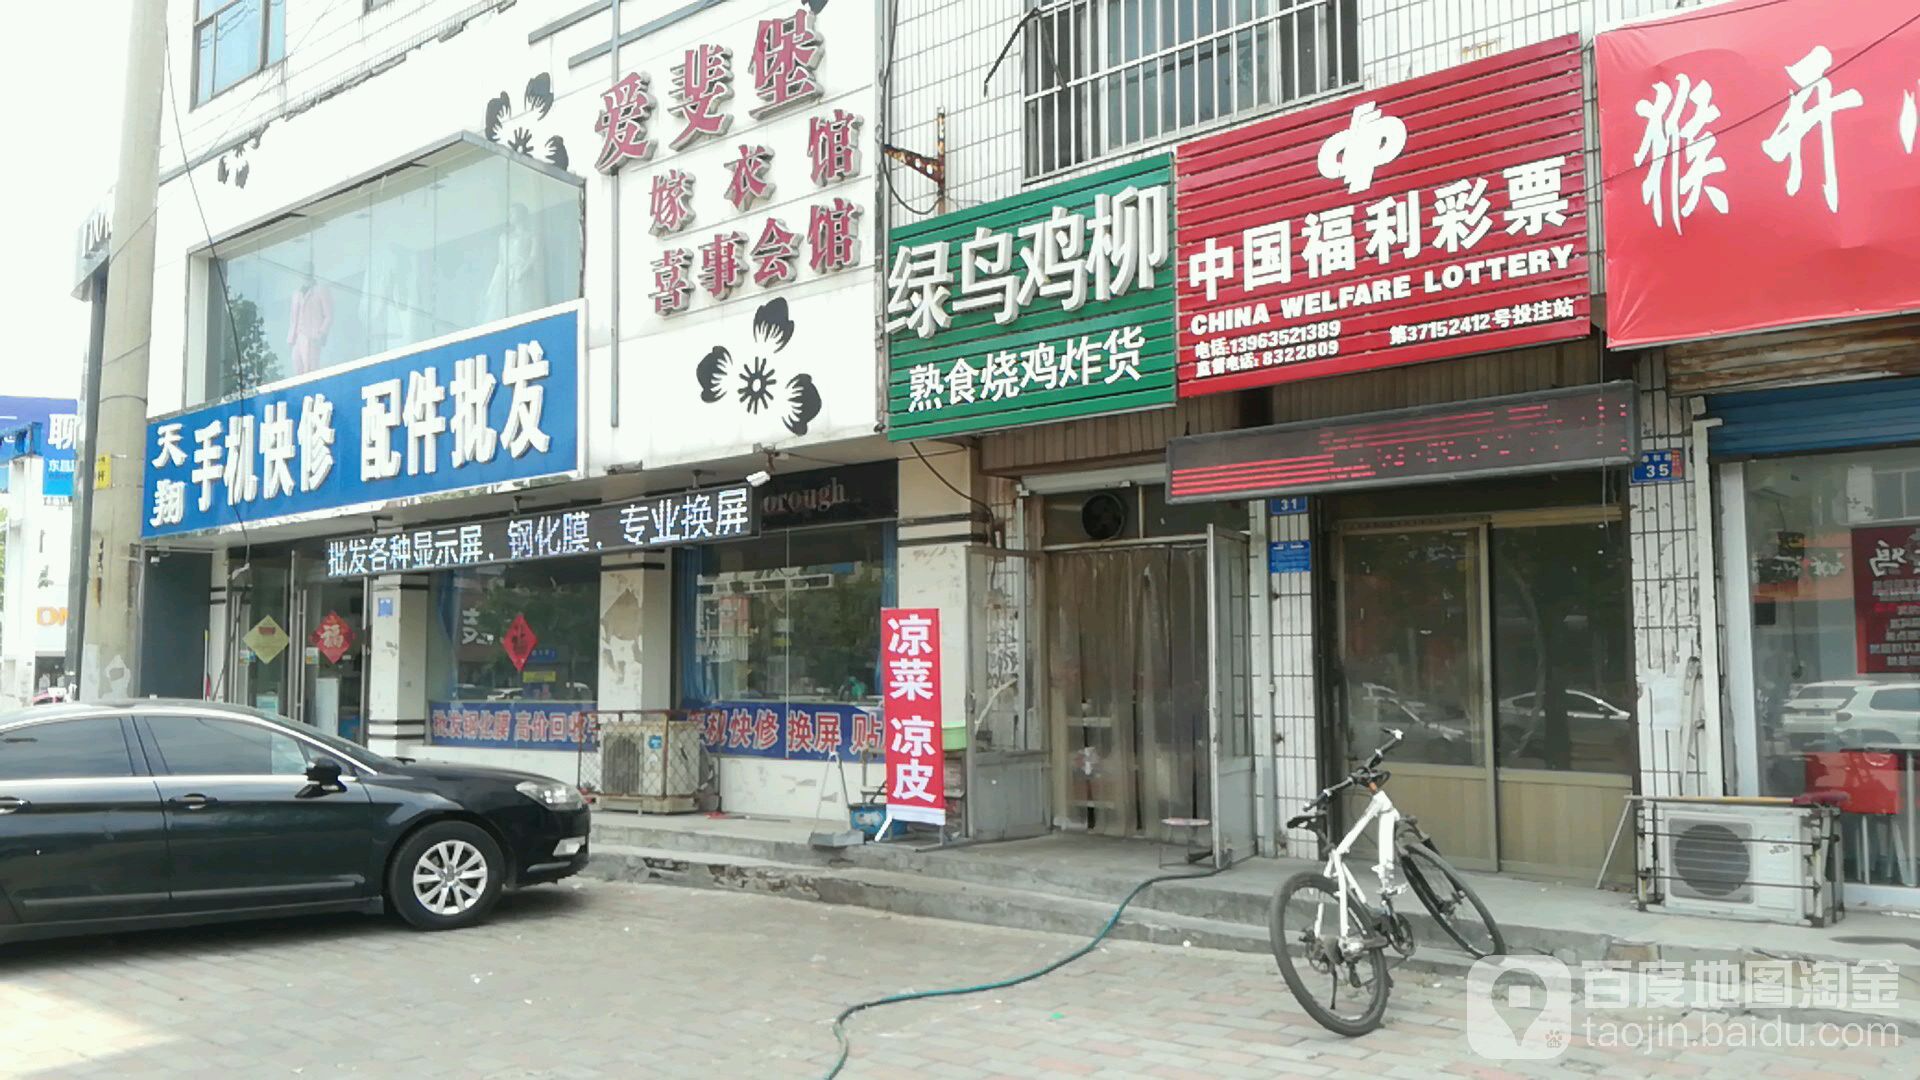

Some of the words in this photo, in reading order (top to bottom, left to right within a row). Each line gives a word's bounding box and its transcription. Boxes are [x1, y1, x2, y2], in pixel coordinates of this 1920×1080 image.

[594, 9, 825, 175] 爱斐堡
[1634, 45, 1920, 236] 猴开
[649, 109, 864, 237] 嫁衣馆
[648, 198, 864, 316] 喜事会馆
[1188, 156, 1569, 301] 中国福利彩票
[1190, 303, 1271, 336] CHINA
[1281, 275, 1412, 319] WELFARE
[1424, 244, 1574, 293] LOTTERY
[1389, 297, 1574, 345] 第37152412号投注站
[908, 326, 1146, 413] 熟食烧鸡炸货
[192, 392, 336, 507] 手机快修
[360, 340, 551, 483] 配件批发
[1646, 463, 1669, 478] 35
[150, 423, 188, 529] 天翔
[1280, 498, 1298, 511] 31
[888, 614, 934, 701] 凉菜
[891, 715, 936, 804] 凉皮
